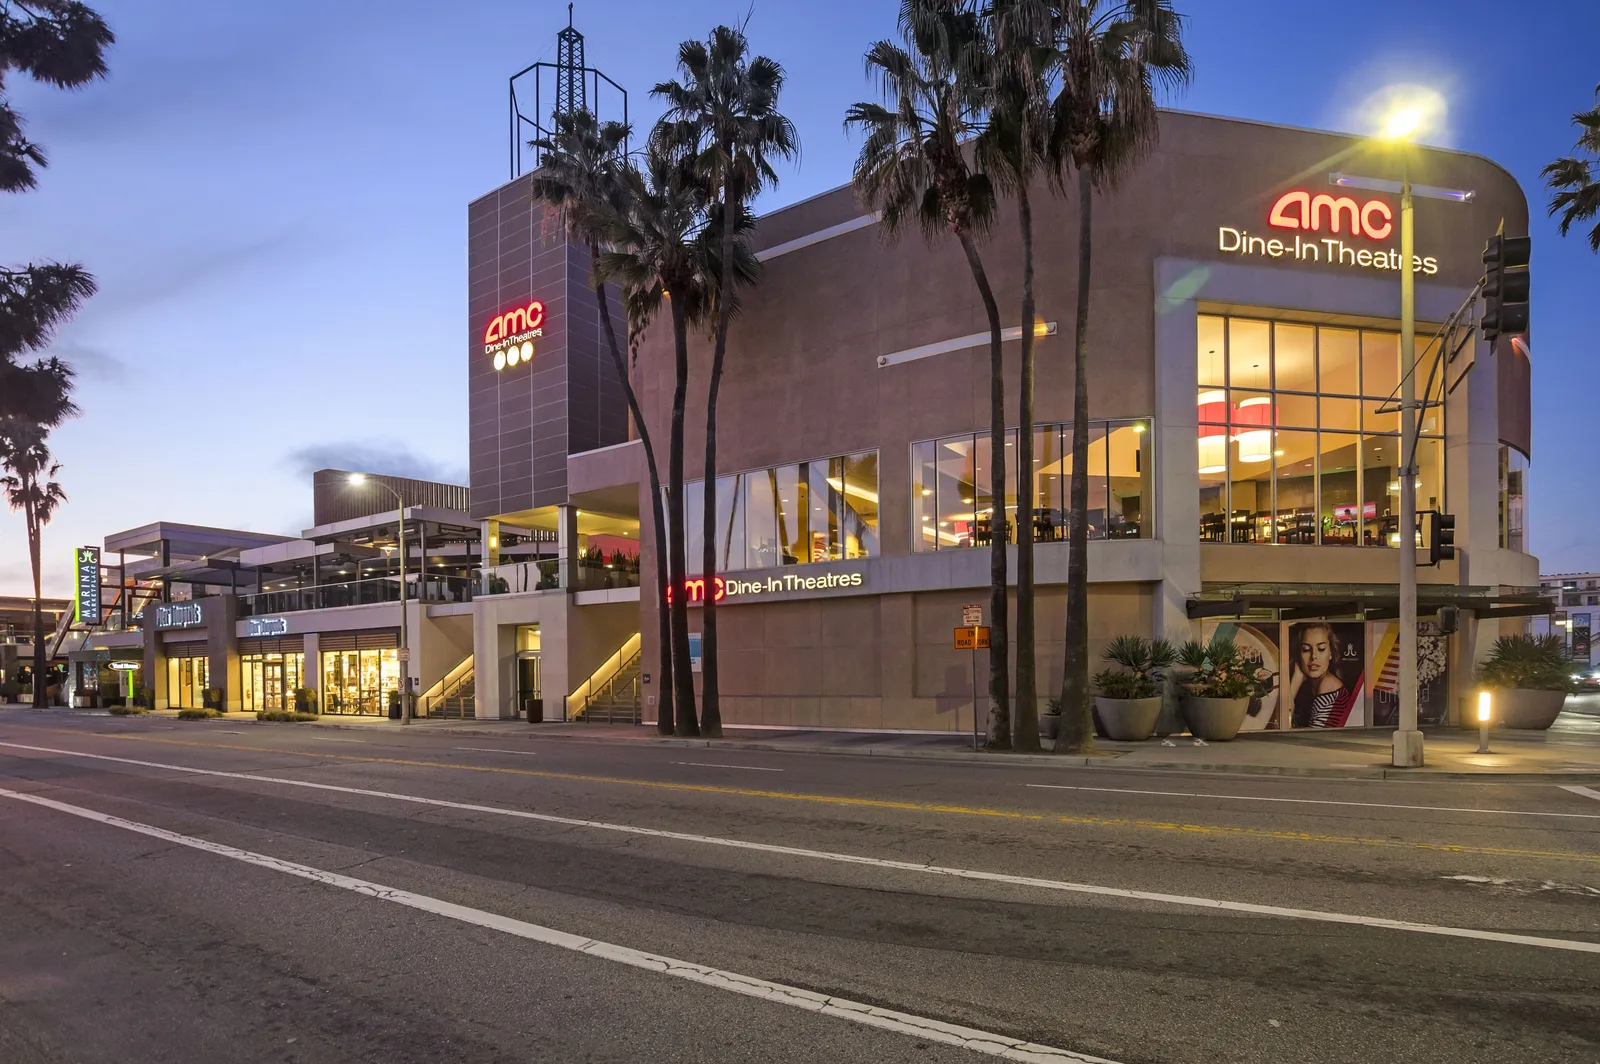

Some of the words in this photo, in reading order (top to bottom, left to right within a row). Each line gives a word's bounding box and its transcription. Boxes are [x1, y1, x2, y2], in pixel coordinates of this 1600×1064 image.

[1219, 227, 1318, 262] Dine-In
[1321, 238, 1438, 275] Theatres
[485, 339, 509, 354] Dine-In
[509, 328, 542, 345] Theatres
[80, 565, 91, 618] MARINA
[726, 576, 783, 596] Dine-In
[784, 572, 862, 592] Theatres
